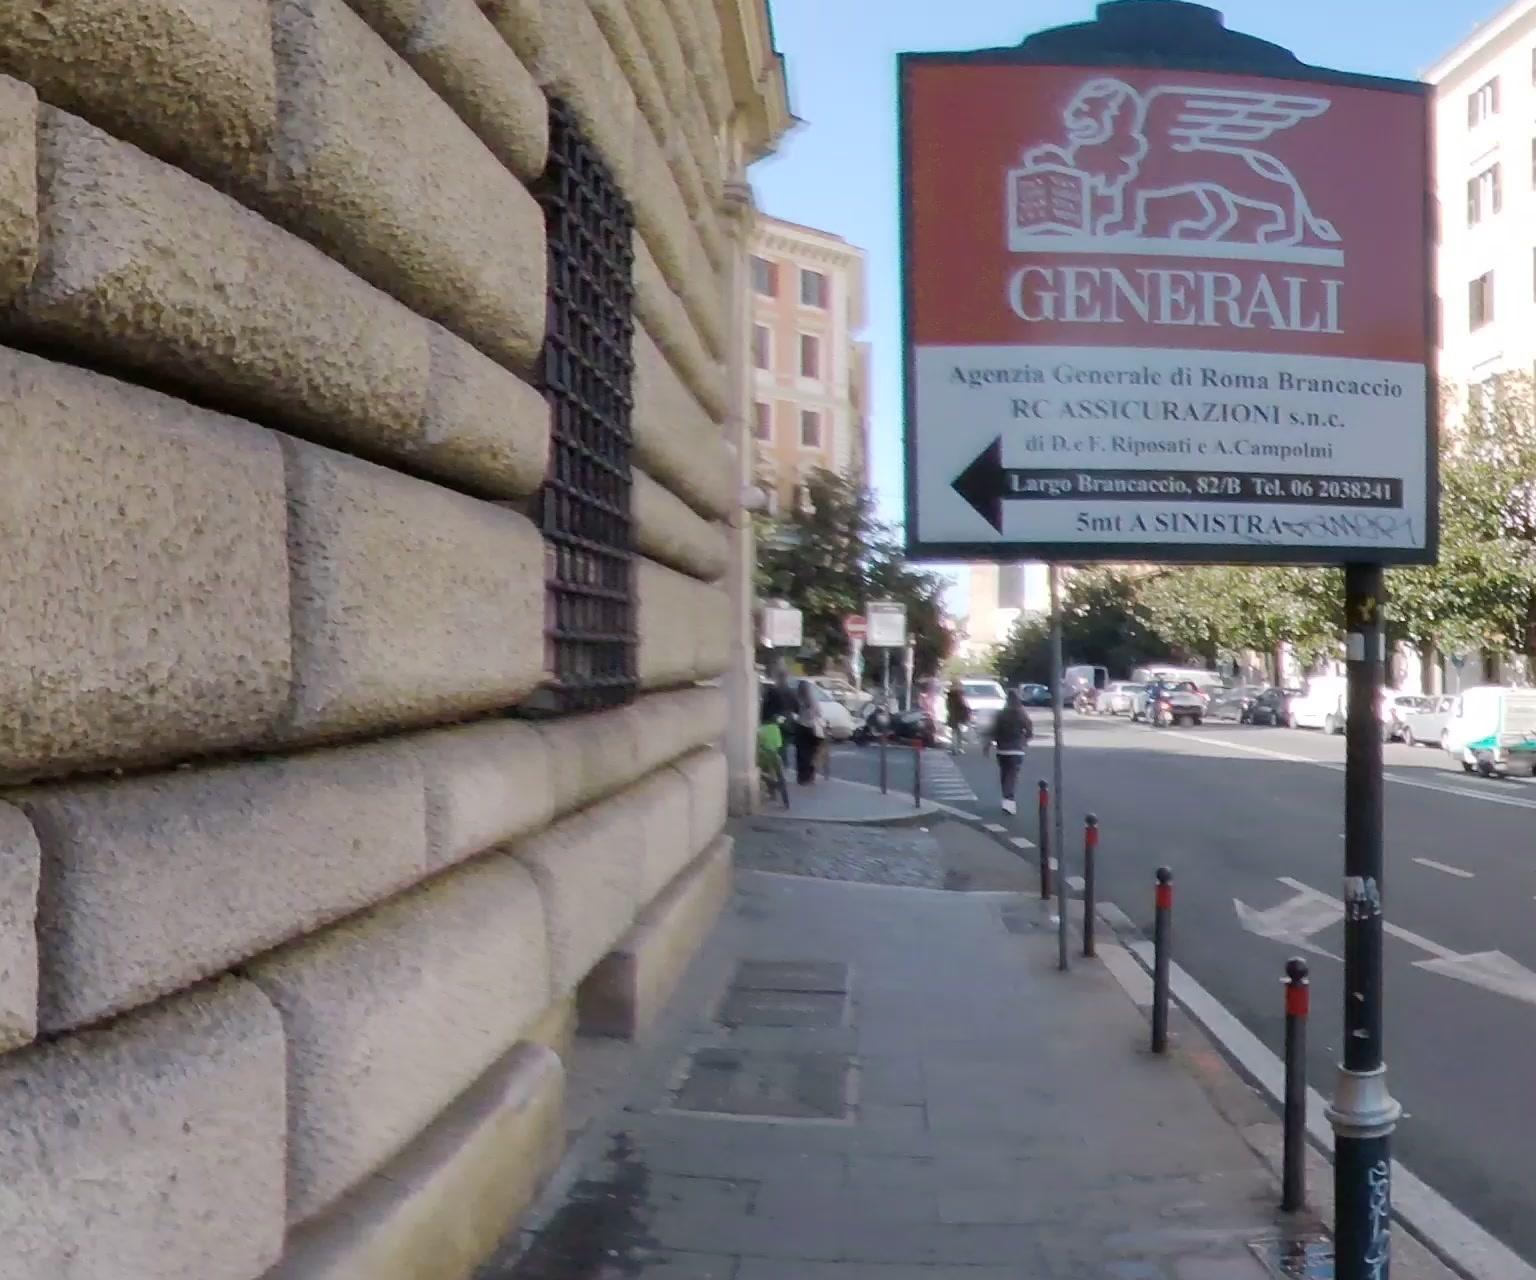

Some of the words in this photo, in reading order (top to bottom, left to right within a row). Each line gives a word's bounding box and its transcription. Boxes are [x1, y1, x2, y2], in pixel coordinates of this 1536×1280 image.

[1008, 265, 1345, 334] GENERALI
[950, 364, 1044, 389] Agenzia
[1054, 364, 1161, 386] Generale
[1171, 367, 1192, 386] di
[1200, 368, 1269, 391] Roma
[1279, 371, 1403, 398] Brancaccio
[1011, 398, 1049, 419] RC
[1059, 400, 1280, 426] ASSICURAZIONI
[1289, 412, 1345, 428] s.n.c.
[1025, 435, 1044, 453] di
[1111, 436, 1192, 457] Riposati
[1010, 473, 1071, 496] Largo
[1076, 474, 1192, 496] Brancaccio,
[1196, 476, 1241, 496] 82/B
[1251, 477, 1286, 498] Tel.
[1290, 479, 1314, 498] 06
[1319, 480, 1392, 502] 2038241
[1076, 511, 1122, 533] 5mt
[1129, 513, 1147, 533] A
[1154, 512, 1283, 536] SINISTRA
